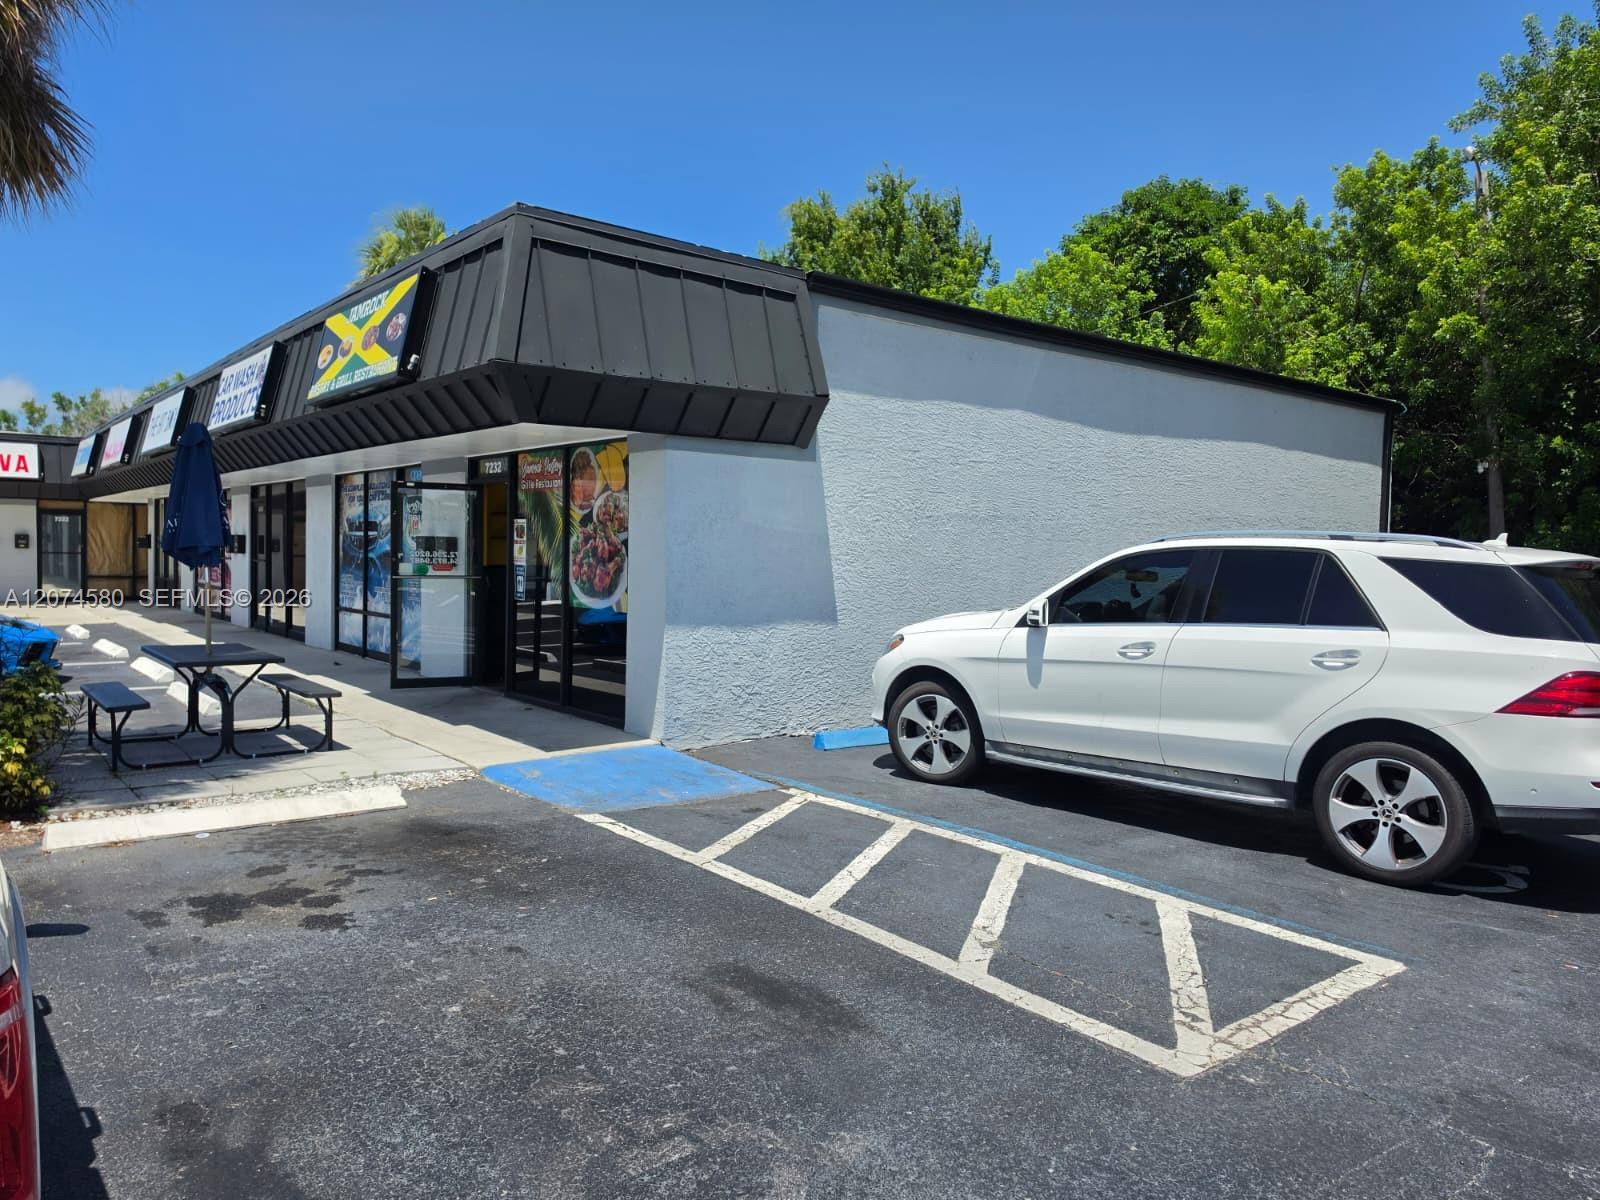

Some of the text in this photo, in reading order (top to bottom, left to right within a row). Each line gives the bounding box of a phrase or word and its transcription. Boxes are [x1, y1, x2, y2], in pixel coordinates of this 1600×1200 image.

[348, 290, 390, 323] JAMROCK
[218, 374, 234, 397] CAR
[233, 362, 258, 391] WASH
[212, 383, 263, 424] PRODUCTS
[485, 461, 502, 474] 7232
